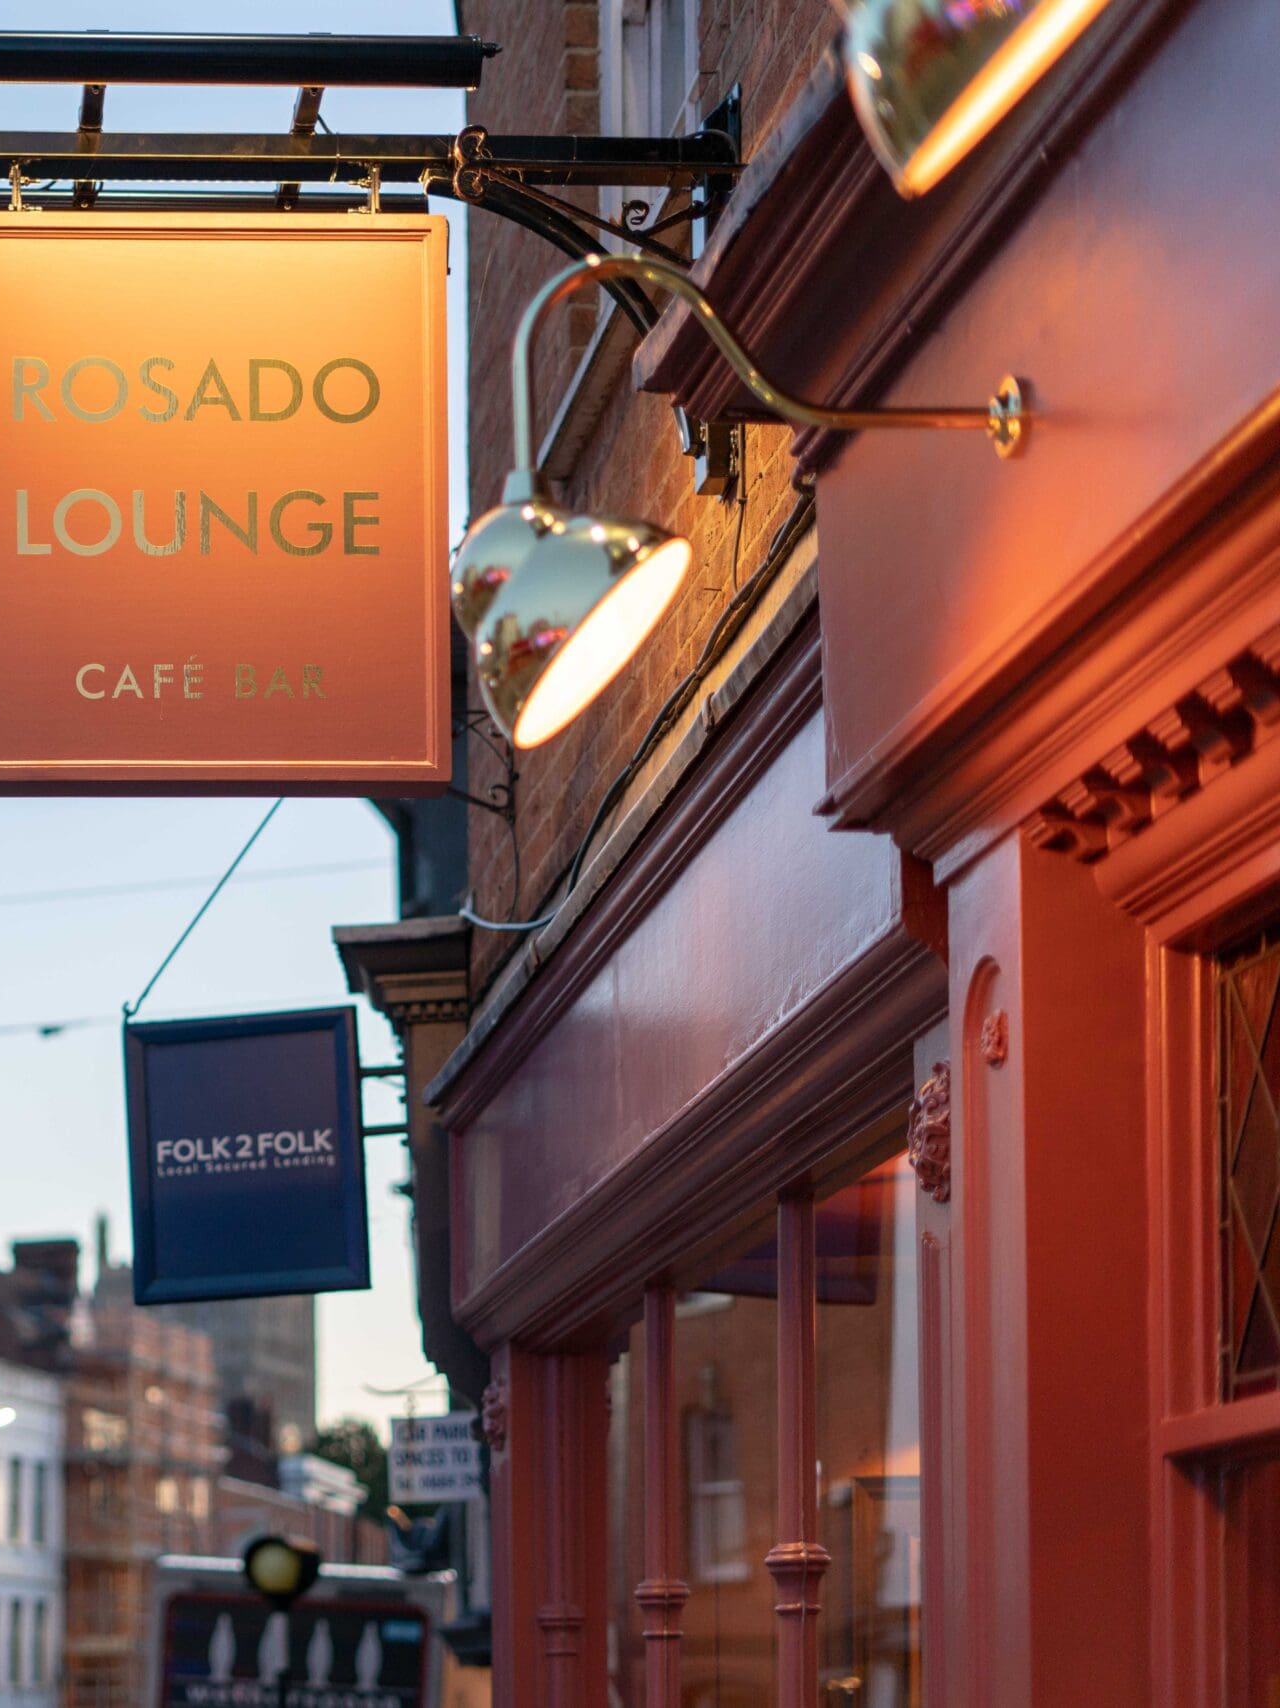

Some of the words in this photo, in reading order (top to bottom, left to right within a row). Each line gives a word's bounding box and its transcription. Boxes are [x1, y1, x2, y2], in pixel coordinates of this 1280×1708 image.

[12, 357, 381, 423] ROSADO
[16, 488, 381, 556] LOUNGE
[75, 655, 205, 699] CAFÉ
[235, 664, 326, 699] BAR
[157, 1162, 199, 1178] Local
[205, 1158, 268, 1174] Secured
[273, 1154, 337, 1169] Lending
